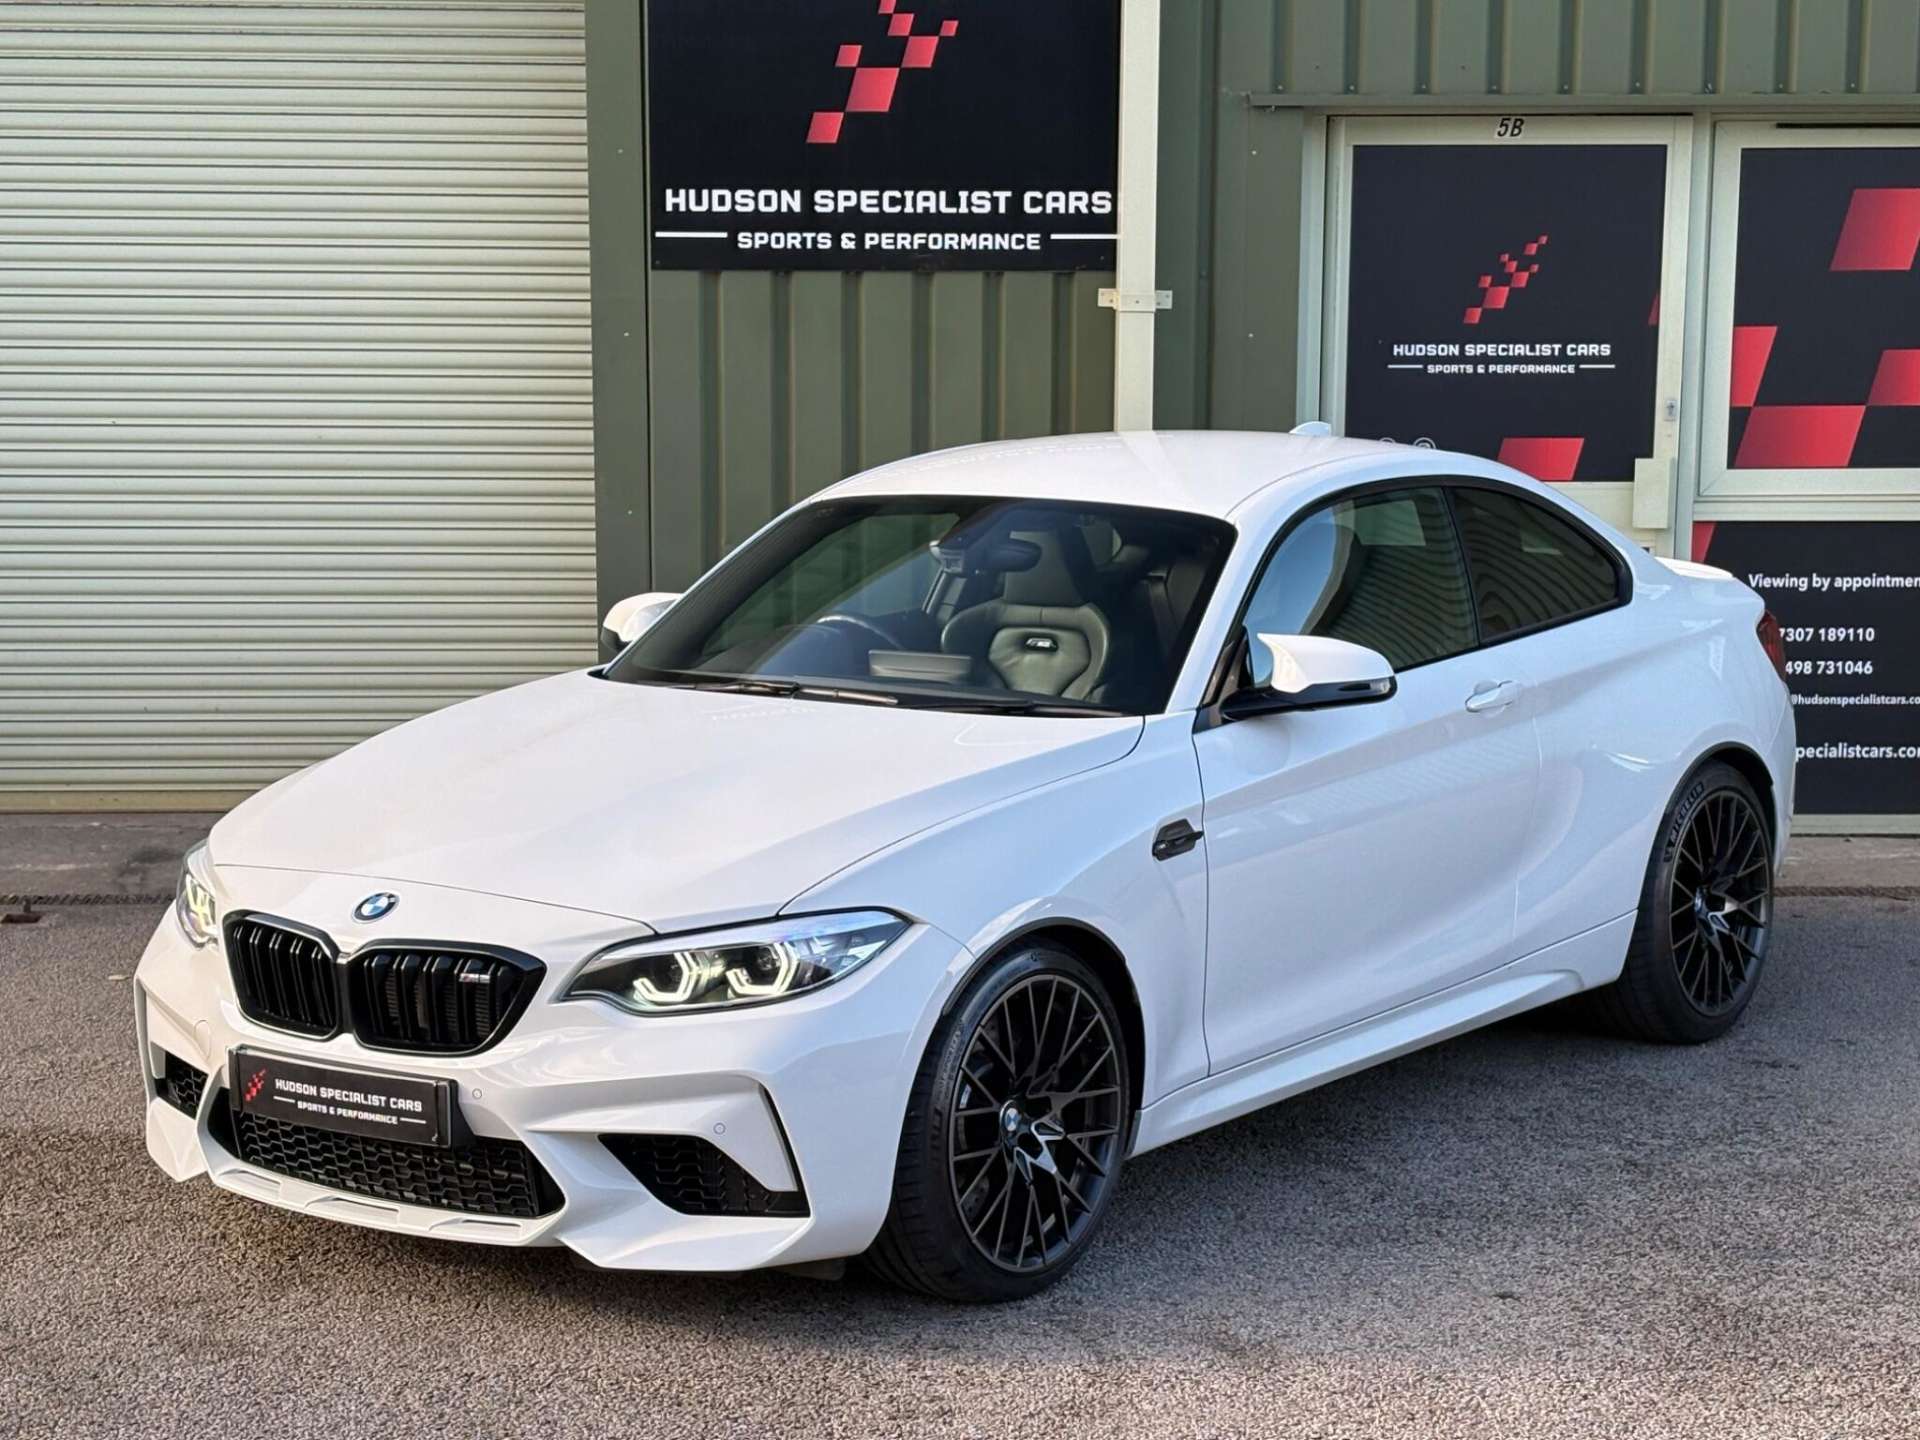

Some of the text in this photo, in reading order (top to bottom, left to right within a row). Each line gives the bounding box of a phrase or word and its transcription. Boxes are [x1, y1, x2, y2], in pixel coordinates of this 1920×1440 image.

[1497, 117, 1525, 137] 5B
[665, 188, 1112, 214] HUDSON SPECIALIST CARS
[737, 231, 1041, 251] SPORTS & PERFORMANCE
[1393, 343, 1612, 357] HUDSON SPECIALIST CARS
[1426, 363, 1576, 374] SPORTS & PERFORMANCE
[1748, 572, 1920, 592] Viewing by appointmen
[1818, 627, 1876, 642] 189110
[1785, 660, 1873, 675] 498 731046
[274, 1077, 423, 1113] HUDSON SPECIALIST CARS
[297, 1100, 328, 1115] SPORTS
[336, 1107, 399, 1125] PERFORMANCE
